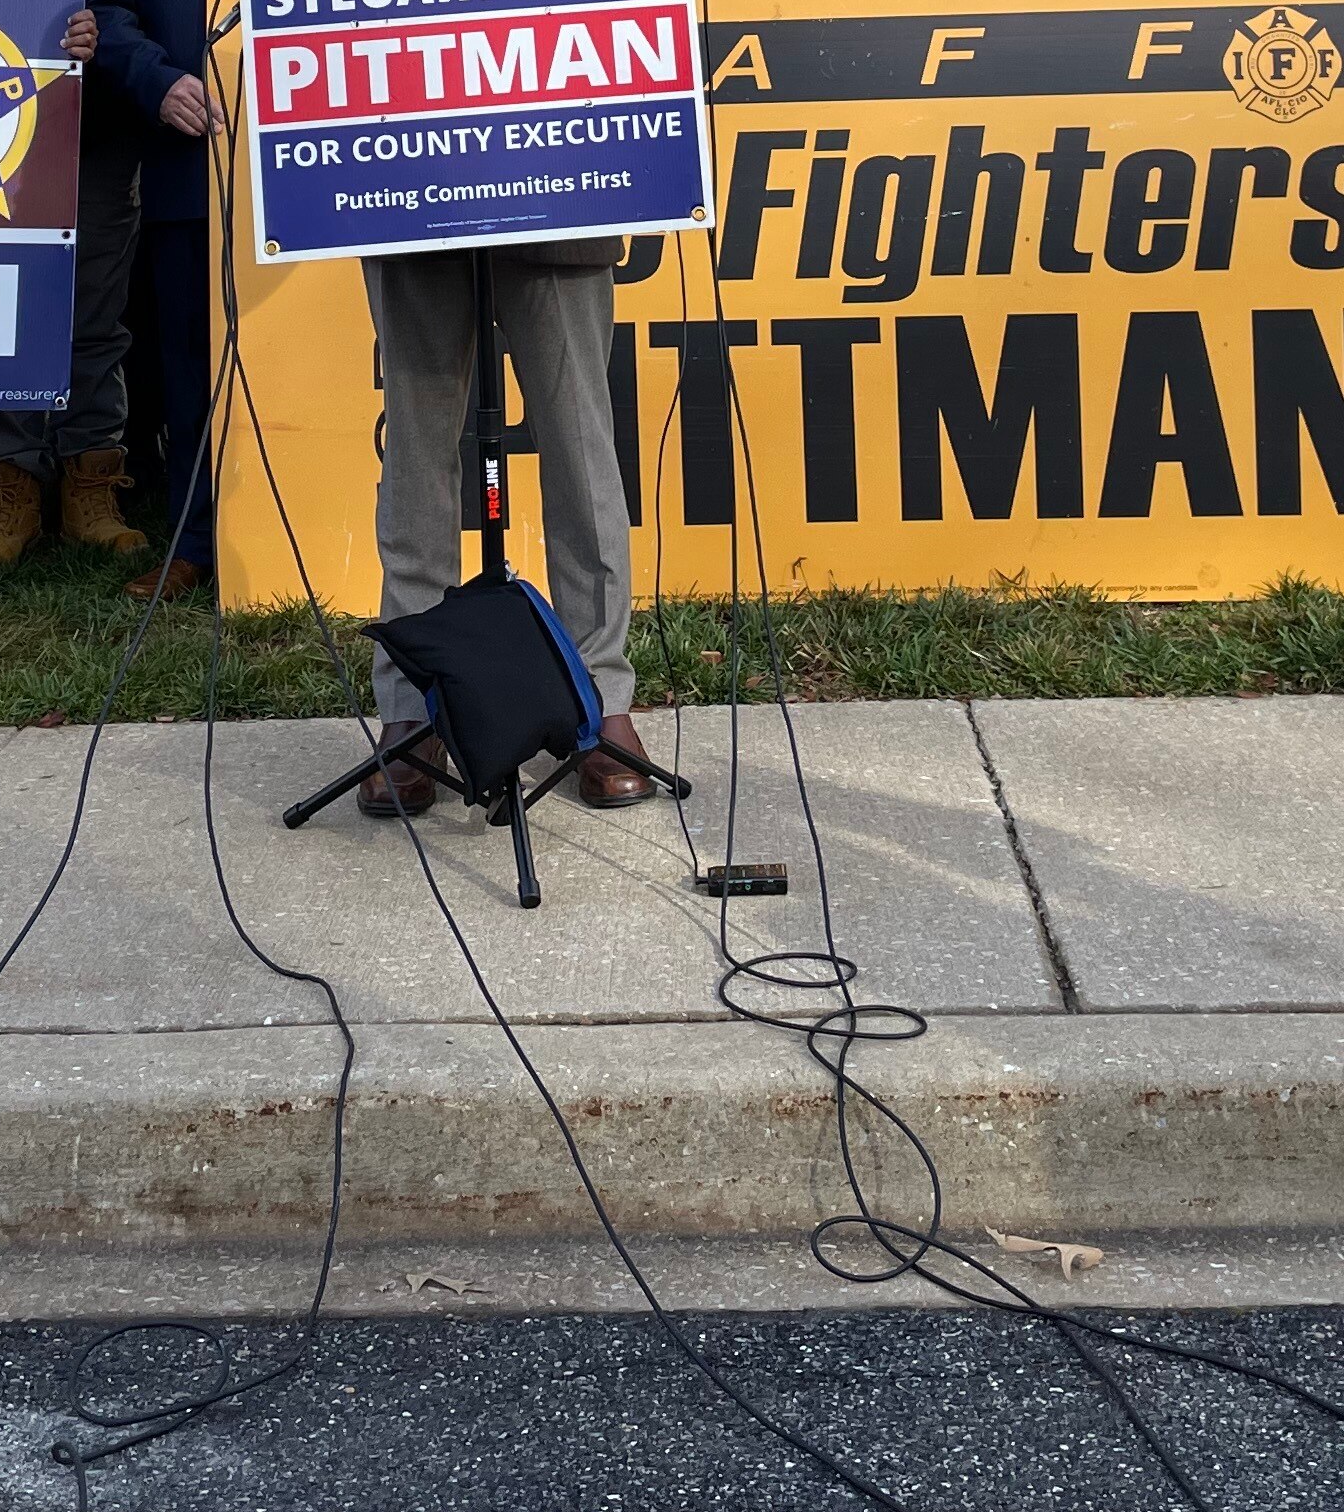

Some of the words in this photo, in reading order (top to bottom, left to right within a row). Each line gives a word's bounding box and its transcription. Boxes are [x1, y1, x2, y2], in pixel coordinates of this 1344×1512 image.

[269, 17, 678, 112] PITTMAN
[274, 139, 342, 169] FOR
[352, 126, 494, 163] COUNTY
[504, 111, 684, 149] EXECUTIVE
[1274, 106, 1297, 116] CLC
[334, 189, 419, 211] Putting
[424, 178, 575, 203] Communities
[581, 170, 632, 189] First
[486, 456, 502, 521] PROLINE
